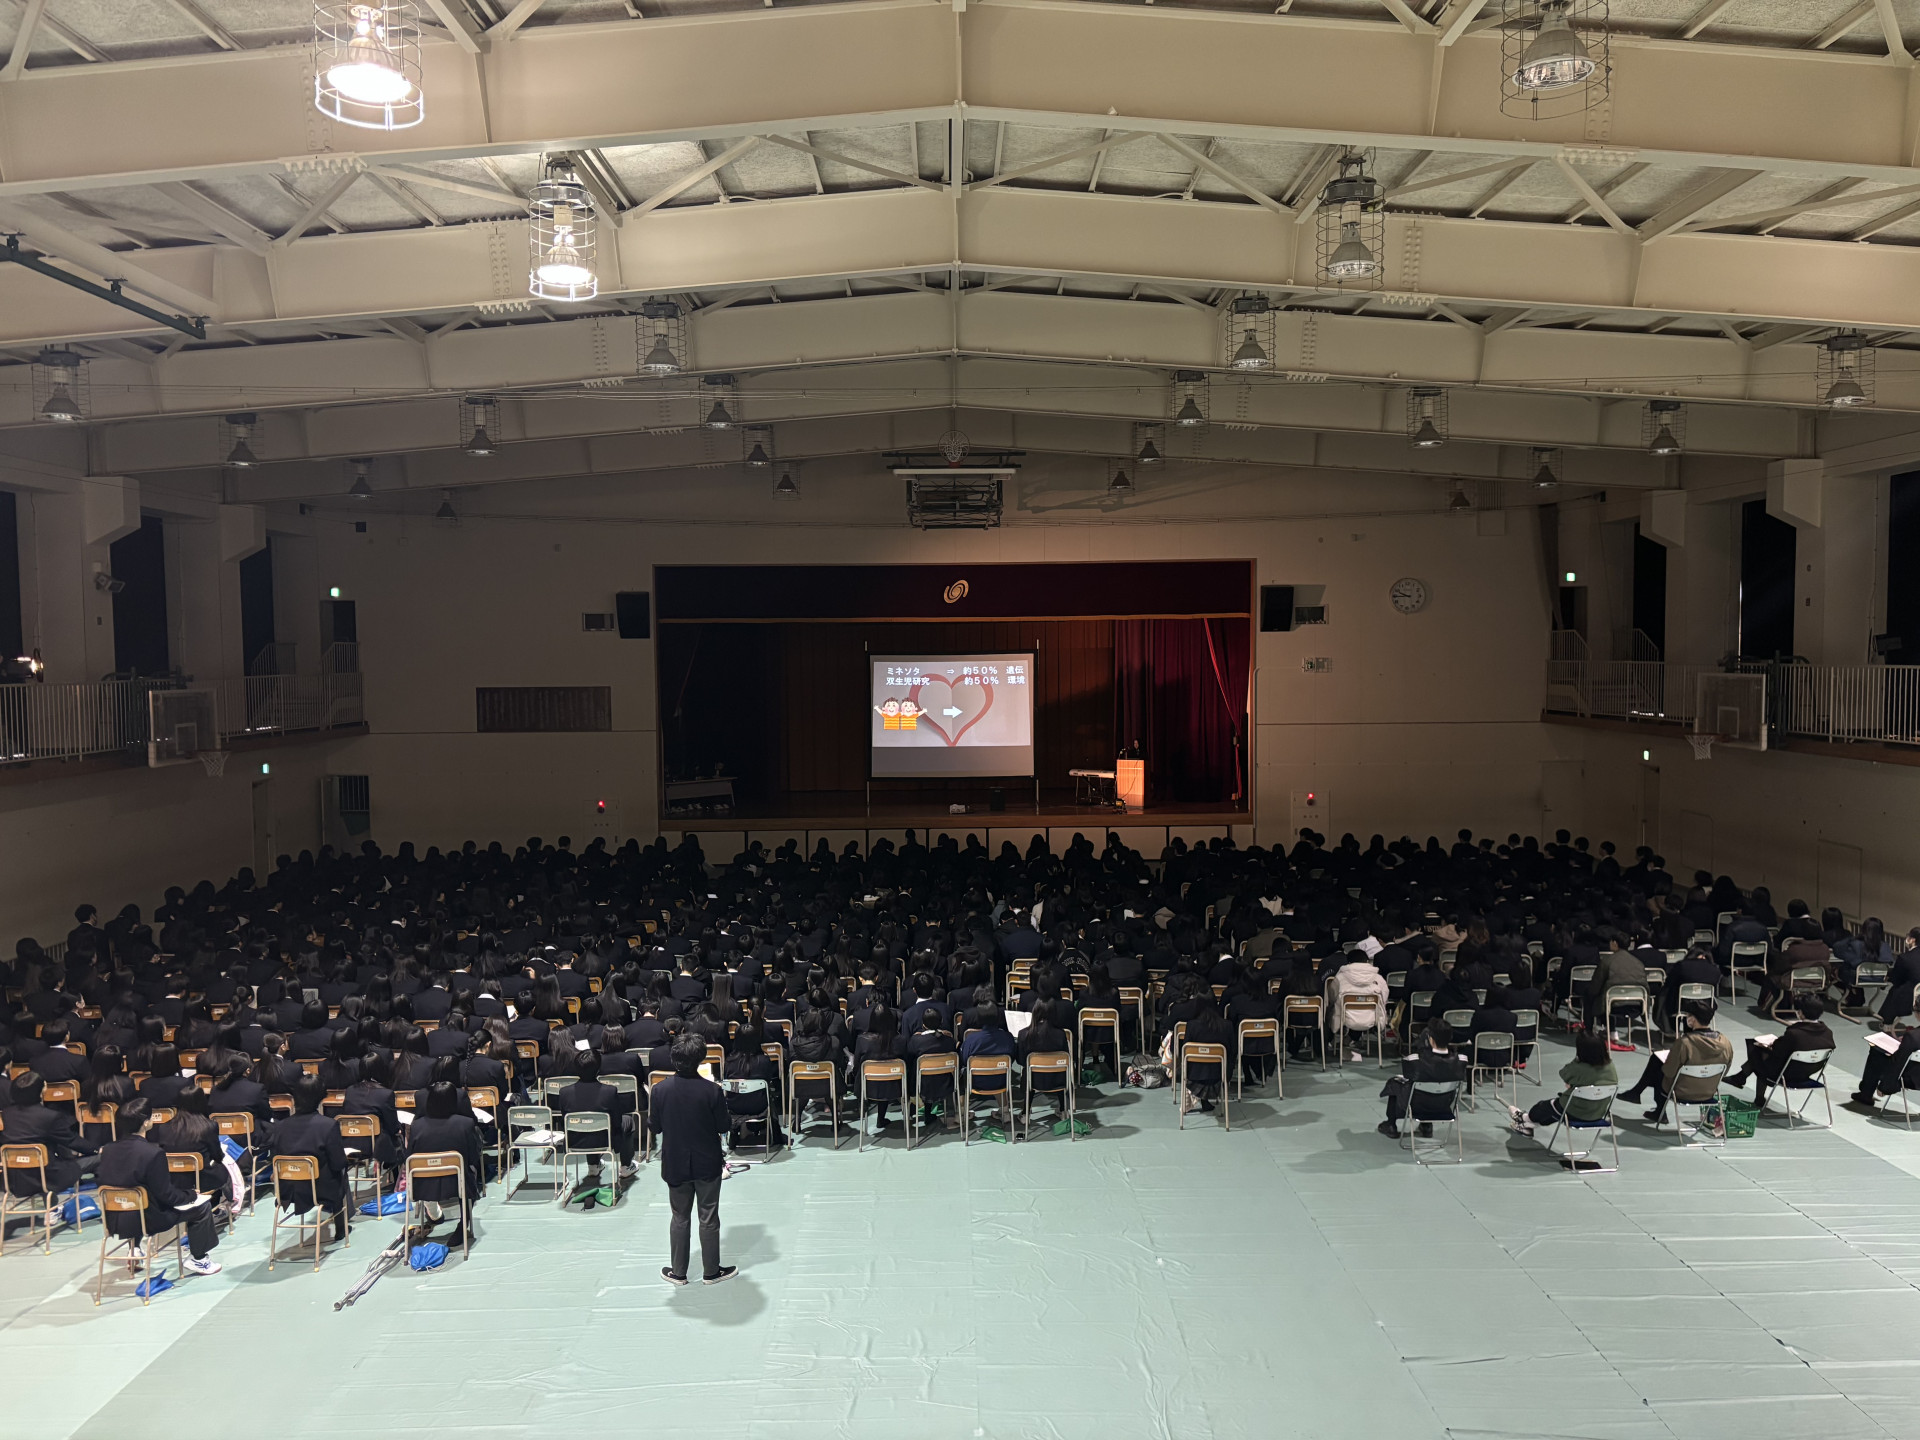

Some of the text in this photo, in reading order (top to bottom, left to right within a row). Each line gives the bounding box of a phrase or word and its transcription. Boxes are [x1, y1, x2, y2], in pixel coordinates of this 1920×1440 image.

[887, 667, 920, 676] ミネソタ
[1006, 665, 1024, 674] 遺伝
[886, 677, 930, 685] 双生児研究
[1007, 675, 1025, 684] 環境
